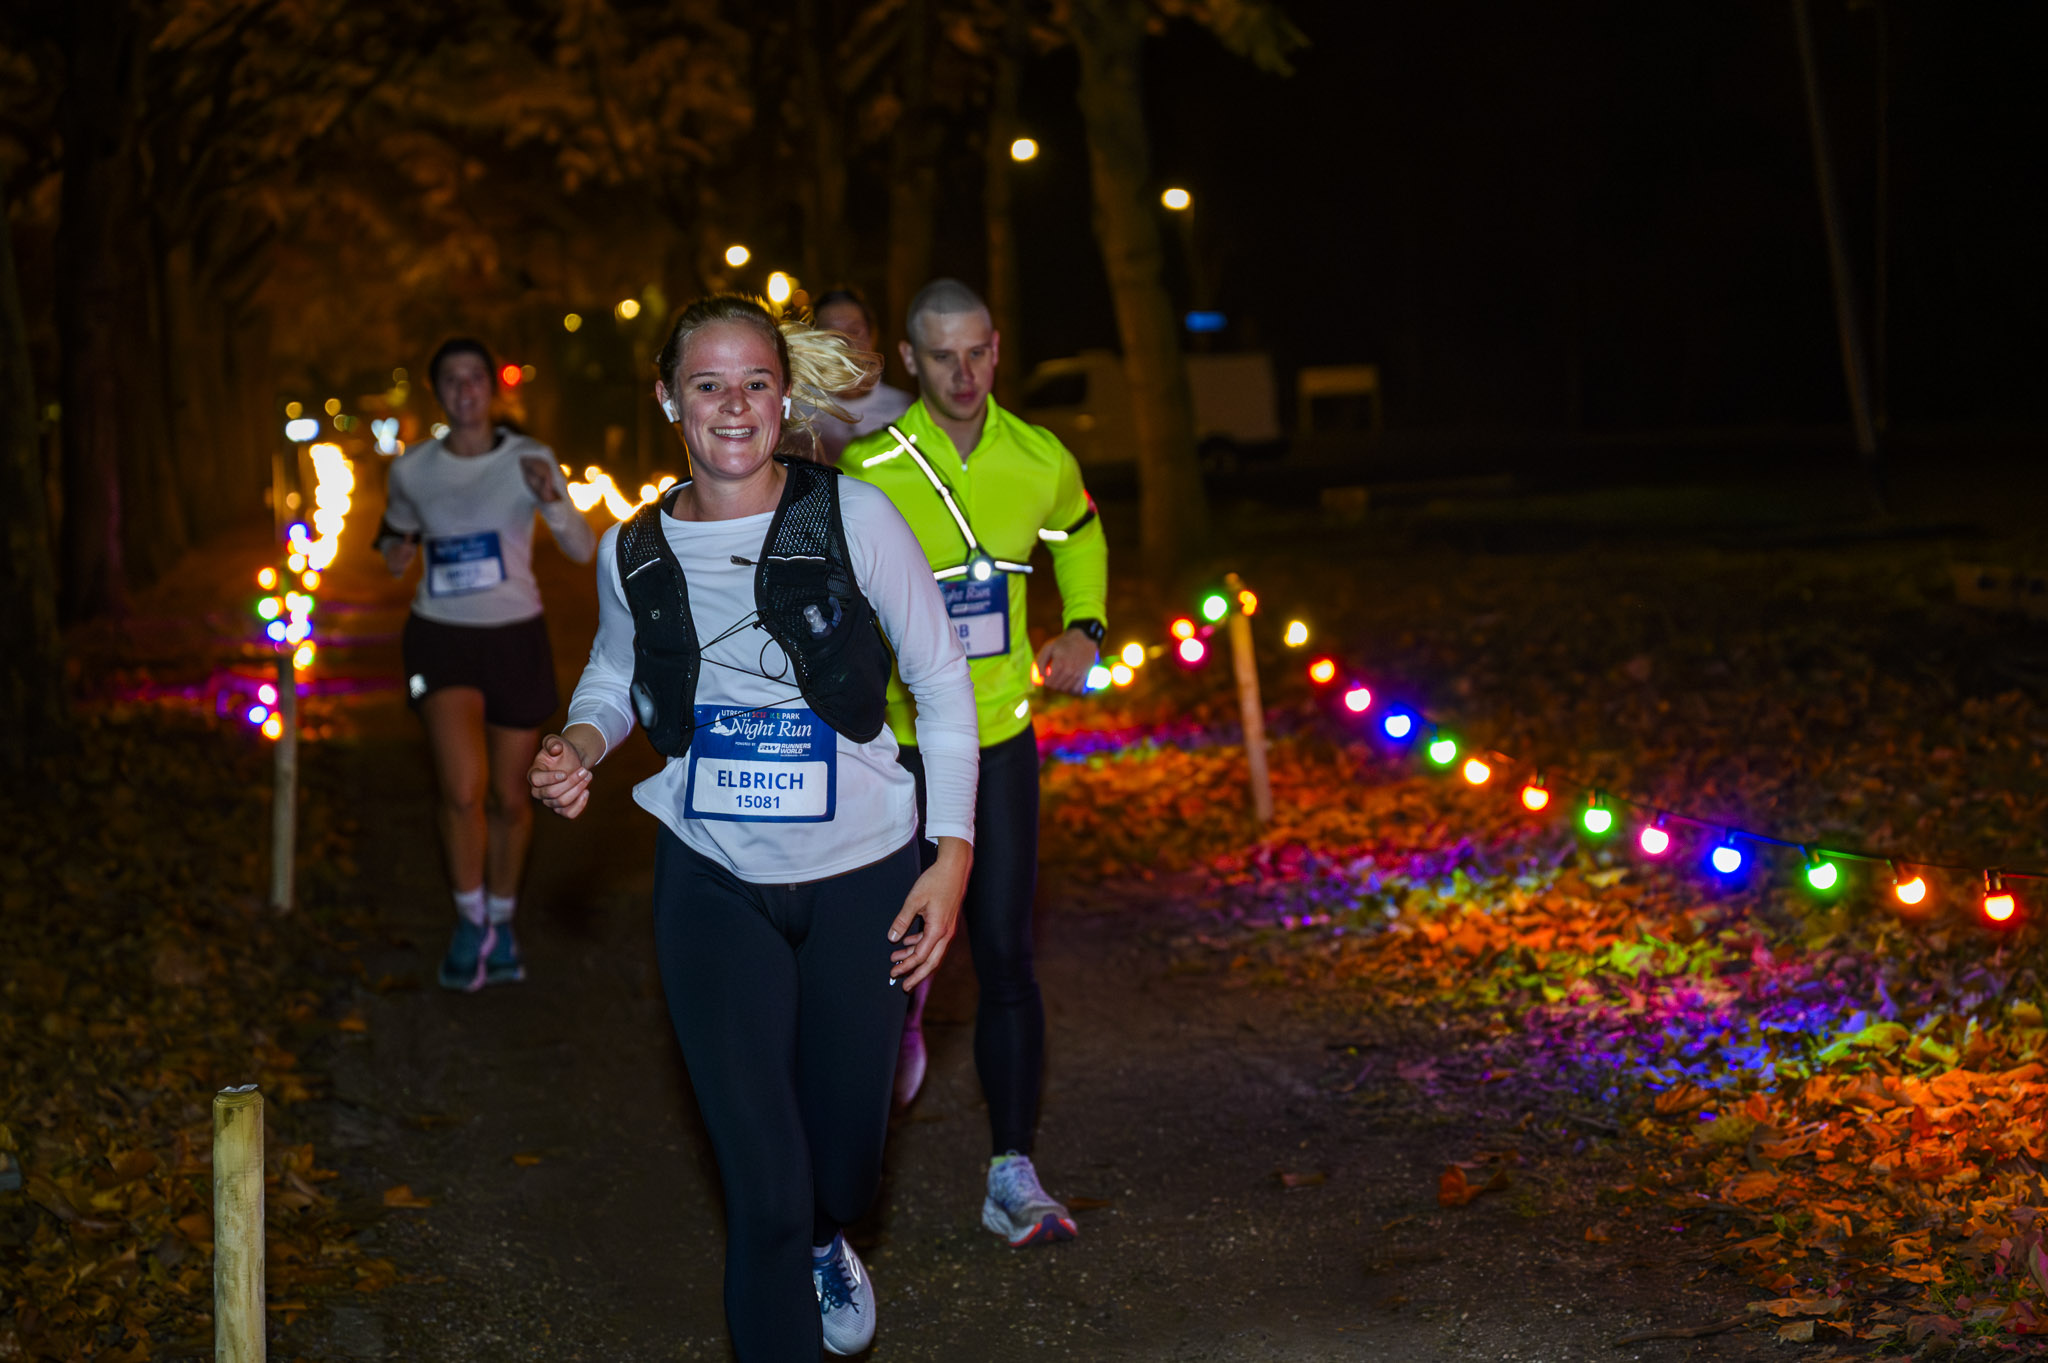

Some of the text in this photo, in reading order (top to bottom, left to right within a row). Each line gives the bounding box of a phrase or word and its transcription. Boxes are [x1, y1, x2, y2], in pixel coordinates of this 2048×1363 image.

[782, 712, 800, 720] PARK
[731, 718, 812, 740] Night Run
[717, 770, 804, 790] ELBRICH
[735, 794, 780, 809] 15081
